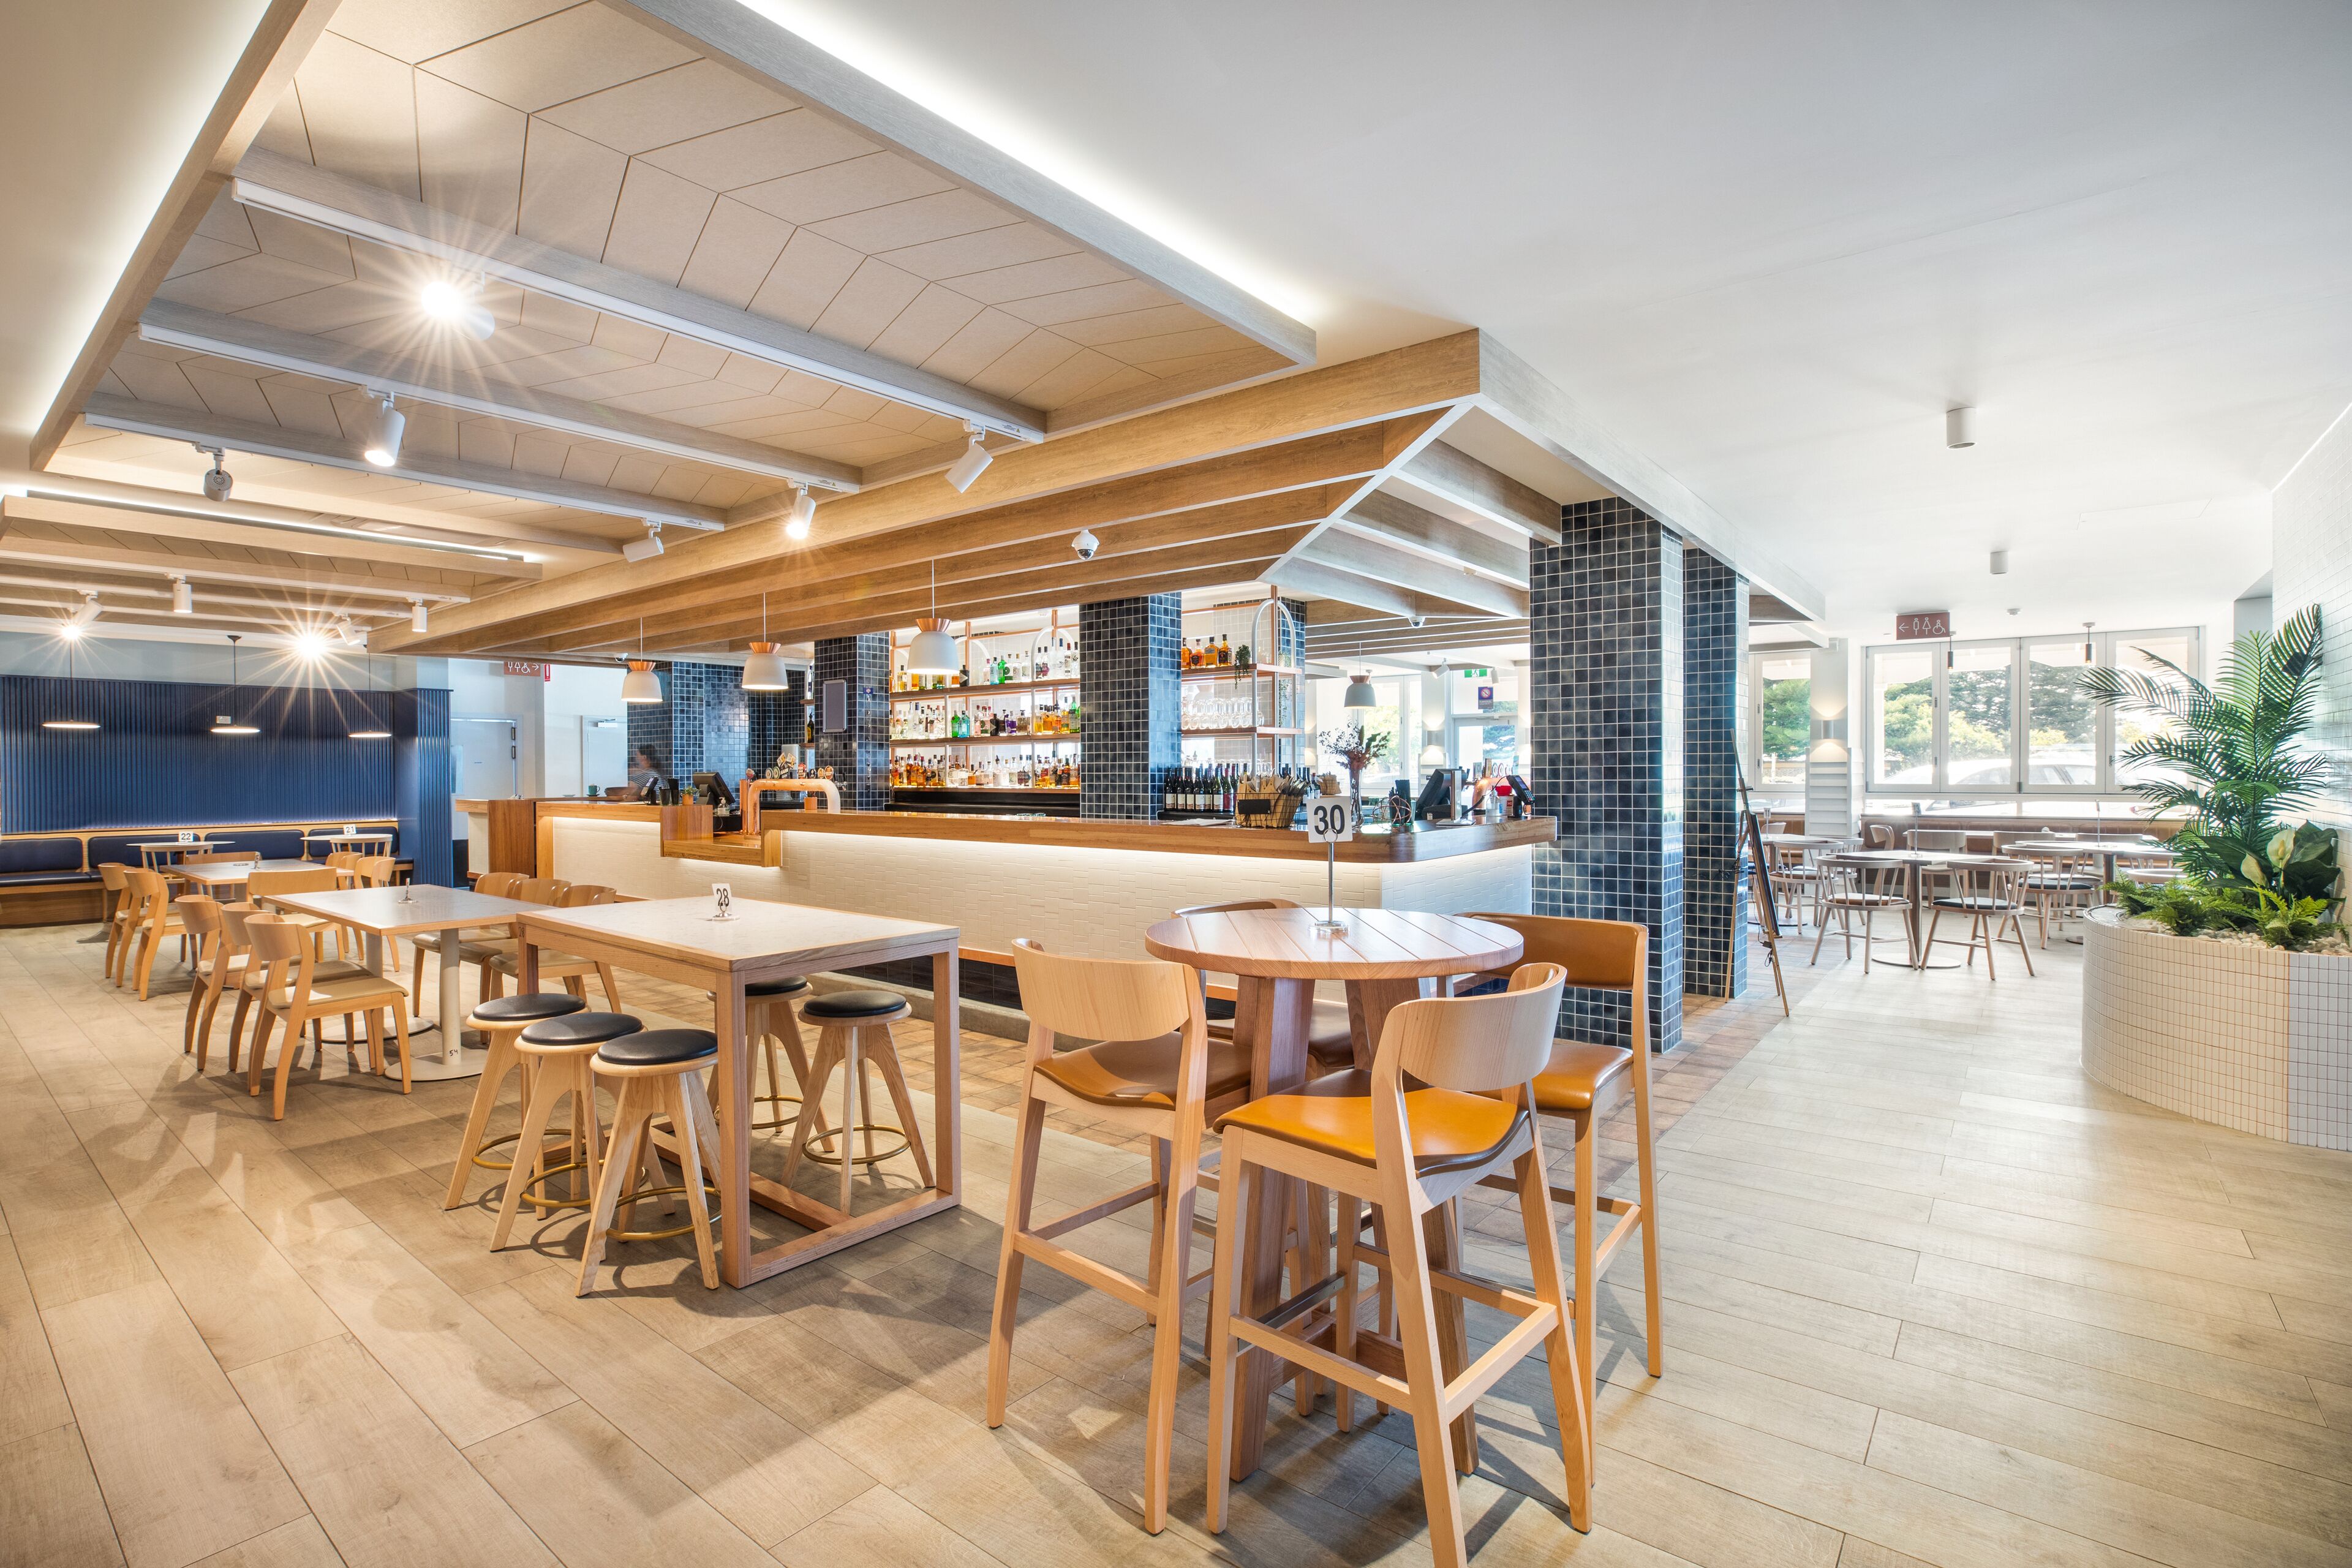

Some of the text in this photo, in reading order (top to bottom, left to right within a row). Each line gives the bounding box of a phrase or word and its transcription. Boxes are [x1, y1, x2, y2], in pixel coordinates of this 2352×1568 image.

[1314, 804, 1345, 835] 30
[716, 888, 729, 907] 28
[519, 926, 525, 938] 28
[449, 1049, 459, 1057] 54
